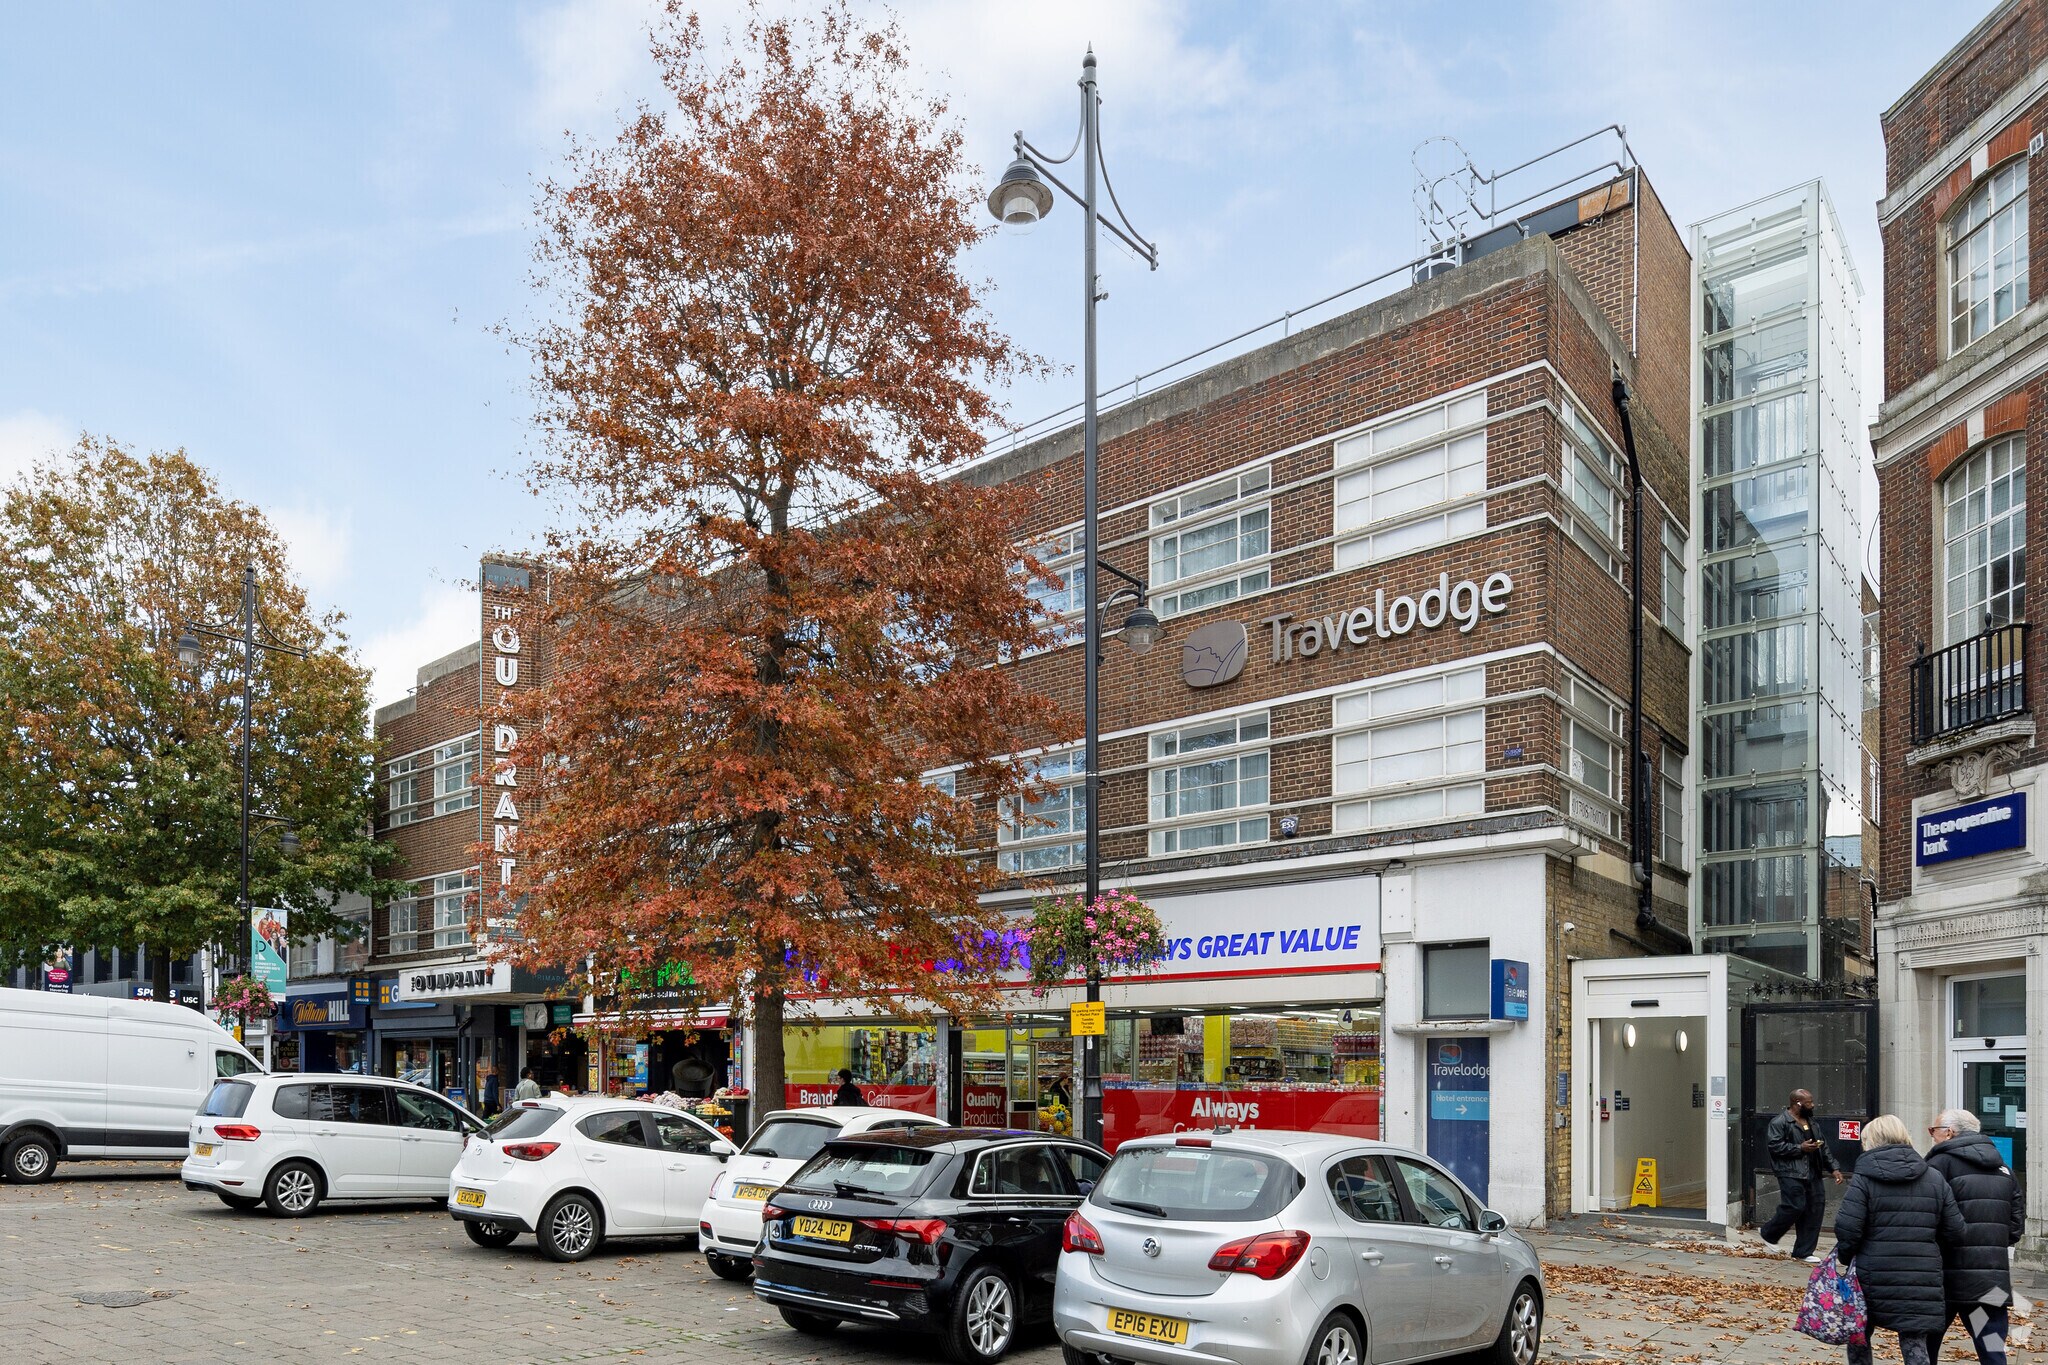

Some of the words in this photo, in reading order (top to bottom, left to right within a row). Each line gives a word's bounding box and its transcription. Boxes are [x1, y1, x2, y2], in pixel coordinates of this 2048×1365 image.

[1260, 572, 1514, 663] Travelodge
[1921, 822, 1940, 838] The
[1940, 806, 2012, 833] co-operative
[1922, 837, 1949, 856] bank
[1197, 932, 1274, 958] GREAT
[1279, 925, 1361, 953] VALUE
[415, 969, 495, 991] QUADRANT
[292, 1000, 328, 1025] William
[328, 1000, 350, 1022] HILL
[1342, 1010, 1352, 1023] 4
[1431, 1063, 1490, 1078] Travelodge
[867, 1090, 891, 1106] Can
[966, 1092, 1001, 1109] Quality
[1436, 1094, 1455, 1102] Hotel
[963, 1110, 1005, 1126] Products
[1191, 1097, 1259, 1120] Always
[798, 1219, 824, 1235] YD24
[825, 1223, 847, 1237] JCP
[1114, 1312, 1147, 1332] EP16
[1149, 1319, 1179, 1339] EXU
